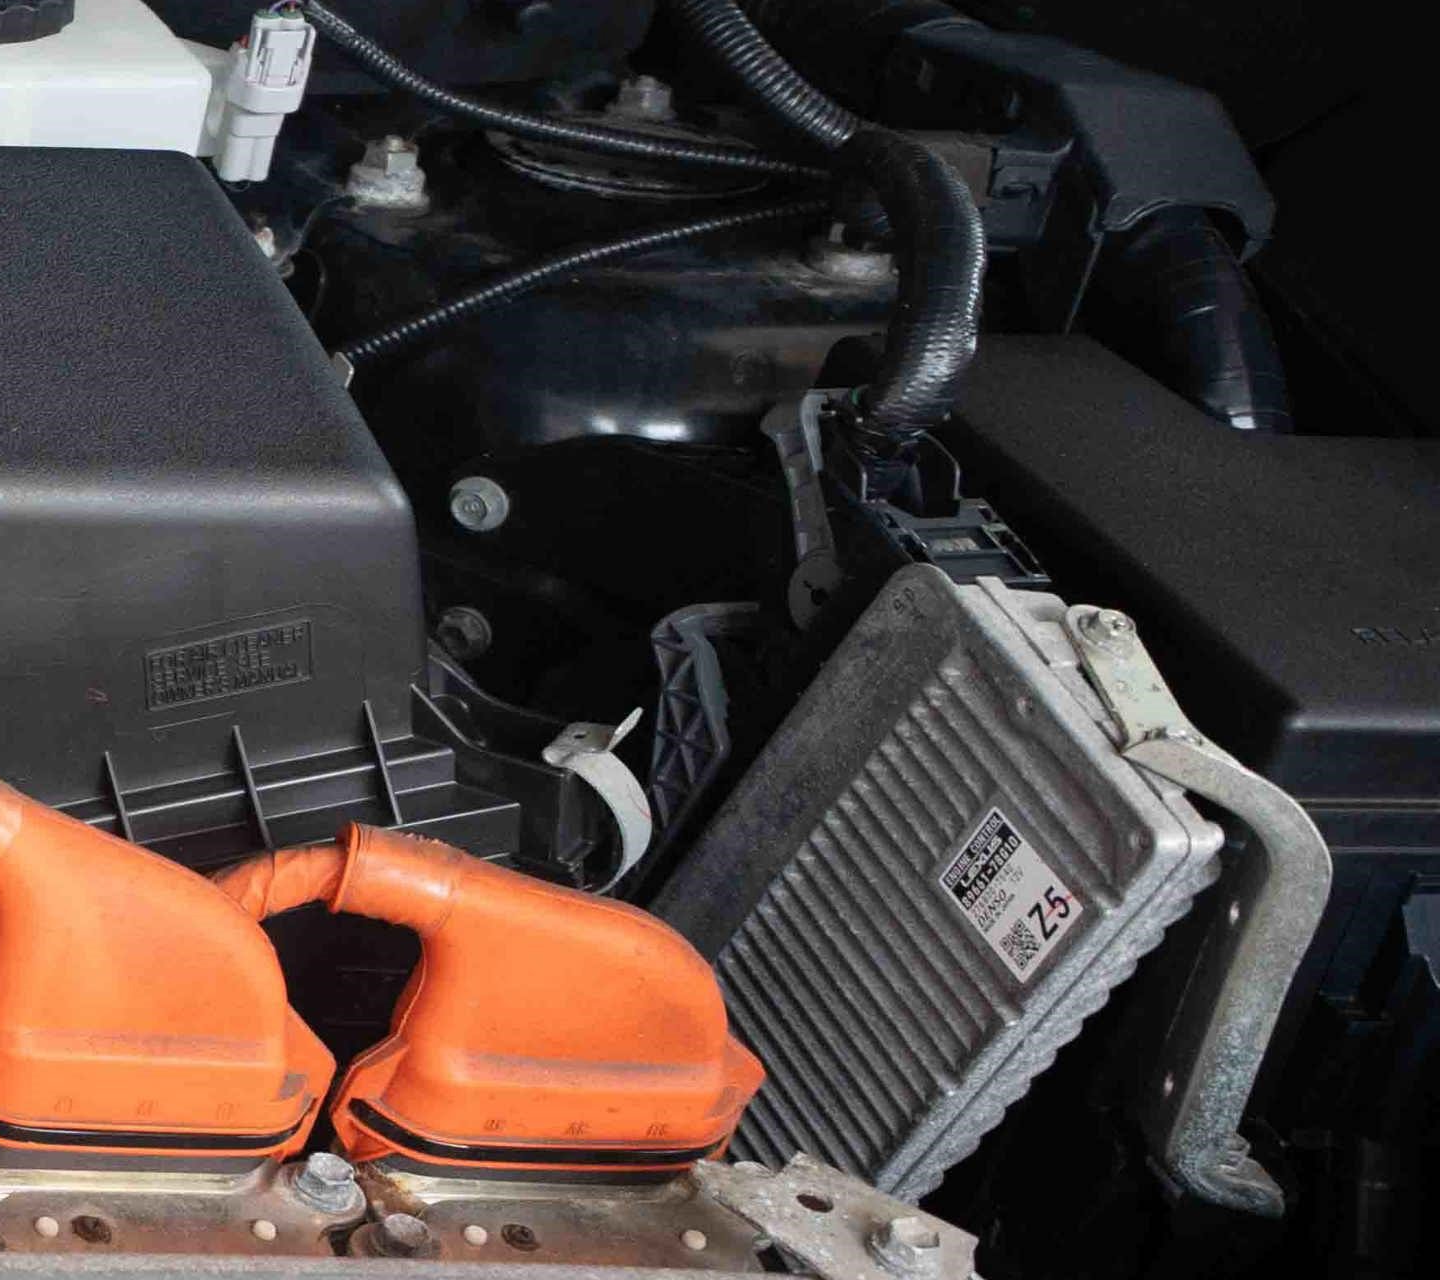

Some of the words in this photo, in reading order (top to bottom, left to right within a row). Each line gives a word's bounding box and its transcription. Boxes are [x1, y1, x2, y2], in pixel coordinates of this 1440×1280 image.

[945, 852, 972, 886] ENGINE
[969, 815, 1001, 855] CONTROL
[960, 835, 1002, 888] LEXUS
[1027, 885, 1073, 941] Z5
